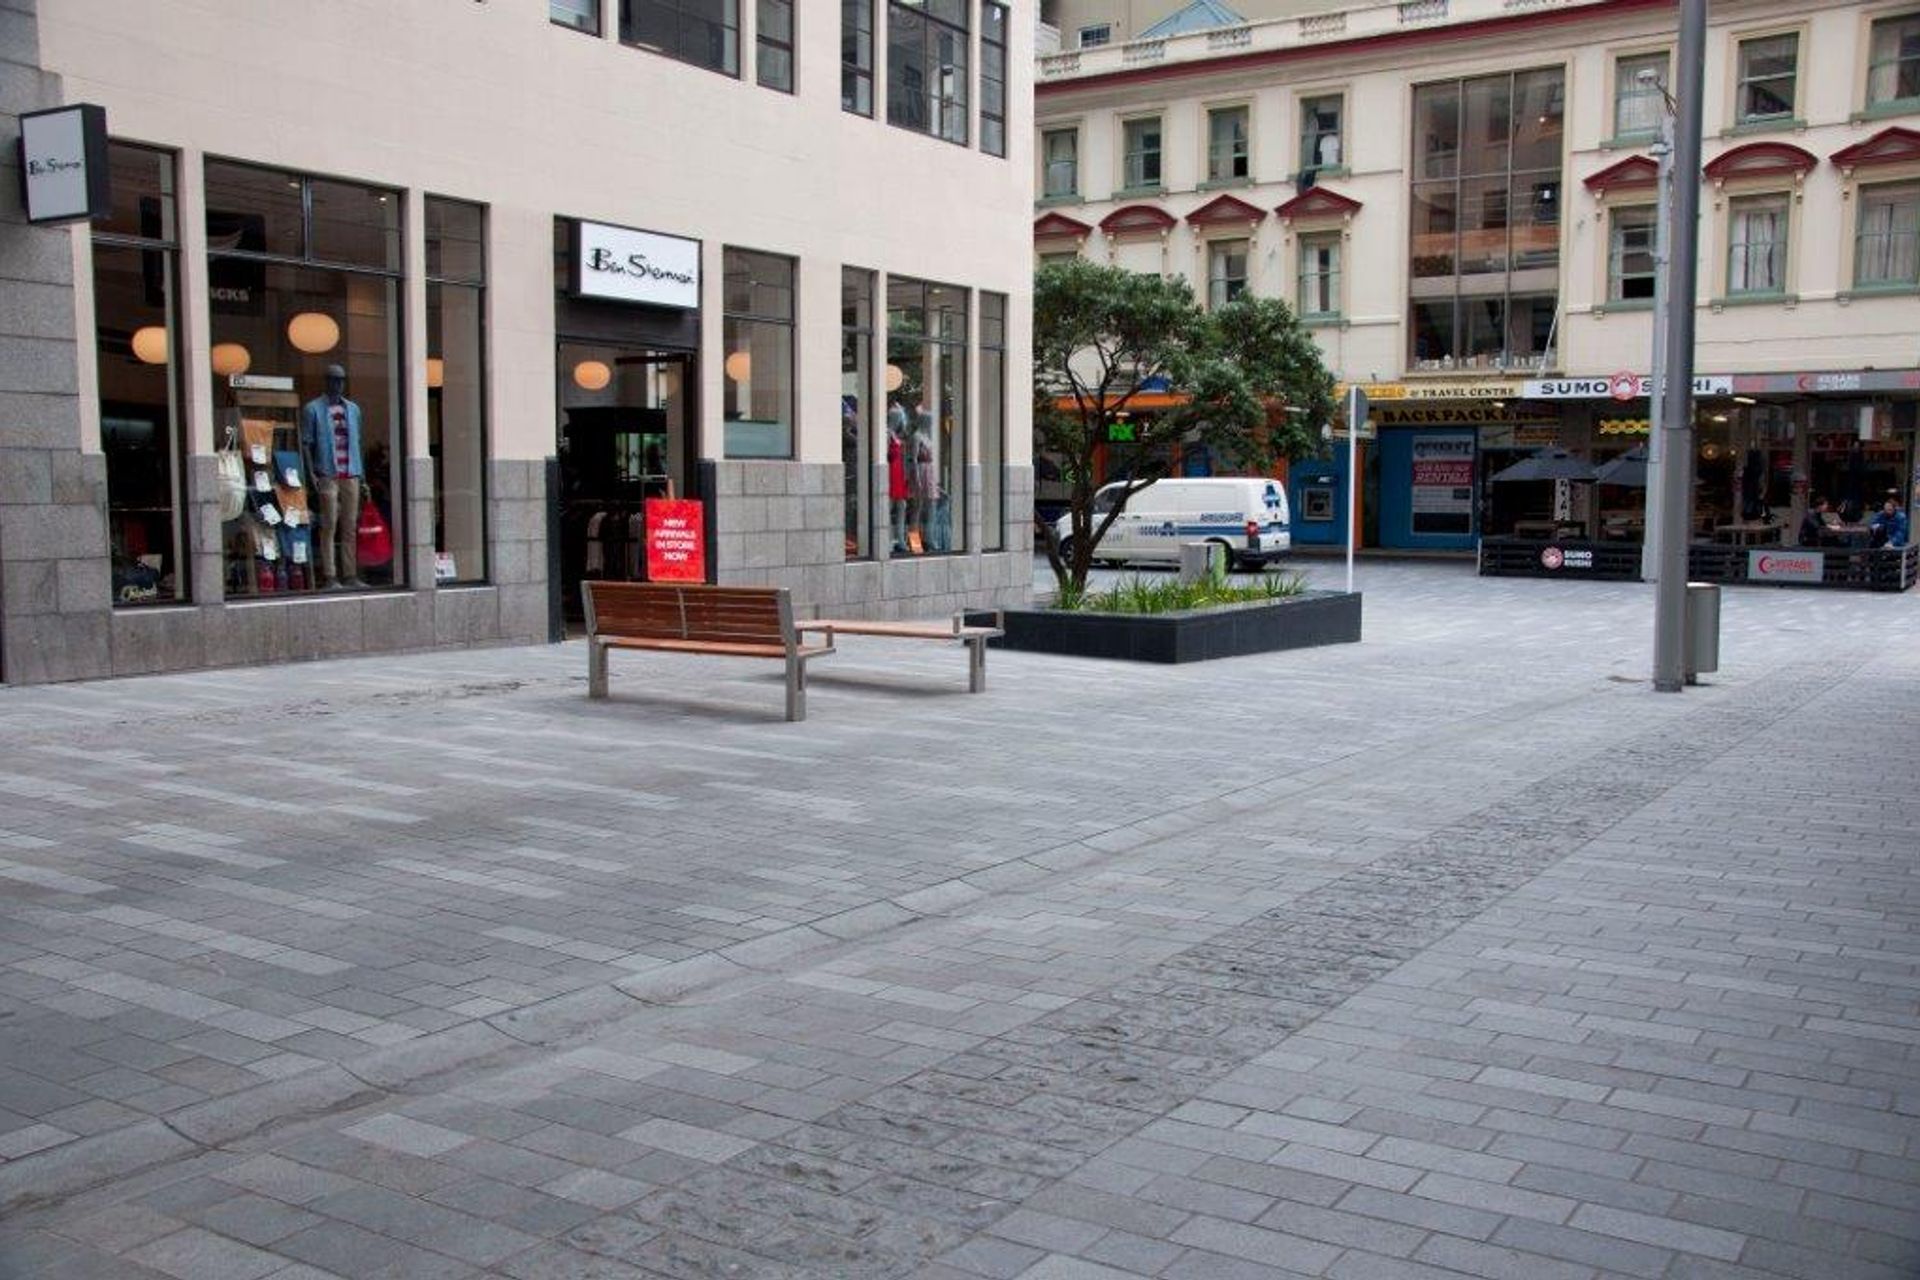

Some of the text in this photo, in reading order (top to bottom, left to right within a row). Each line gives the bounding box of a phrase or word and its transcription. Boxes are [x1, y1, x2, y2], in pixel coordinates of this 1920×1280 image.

[585, 248, 695, 284] Ben Sherman
[1422, 388, 1465, 398] TRAVEL
[1468, 386, 1514, 397] CENTRE
[1541, 381, 1608, 395] SUMO
[1641, 379, 1711, 393] SHI
[663, 519, 688, 528] NEW
[655, 540, 695, 550] IN STORE
[664, 551, 689, 561] NOW
[1564, 550, 1592, 559] SUMO
